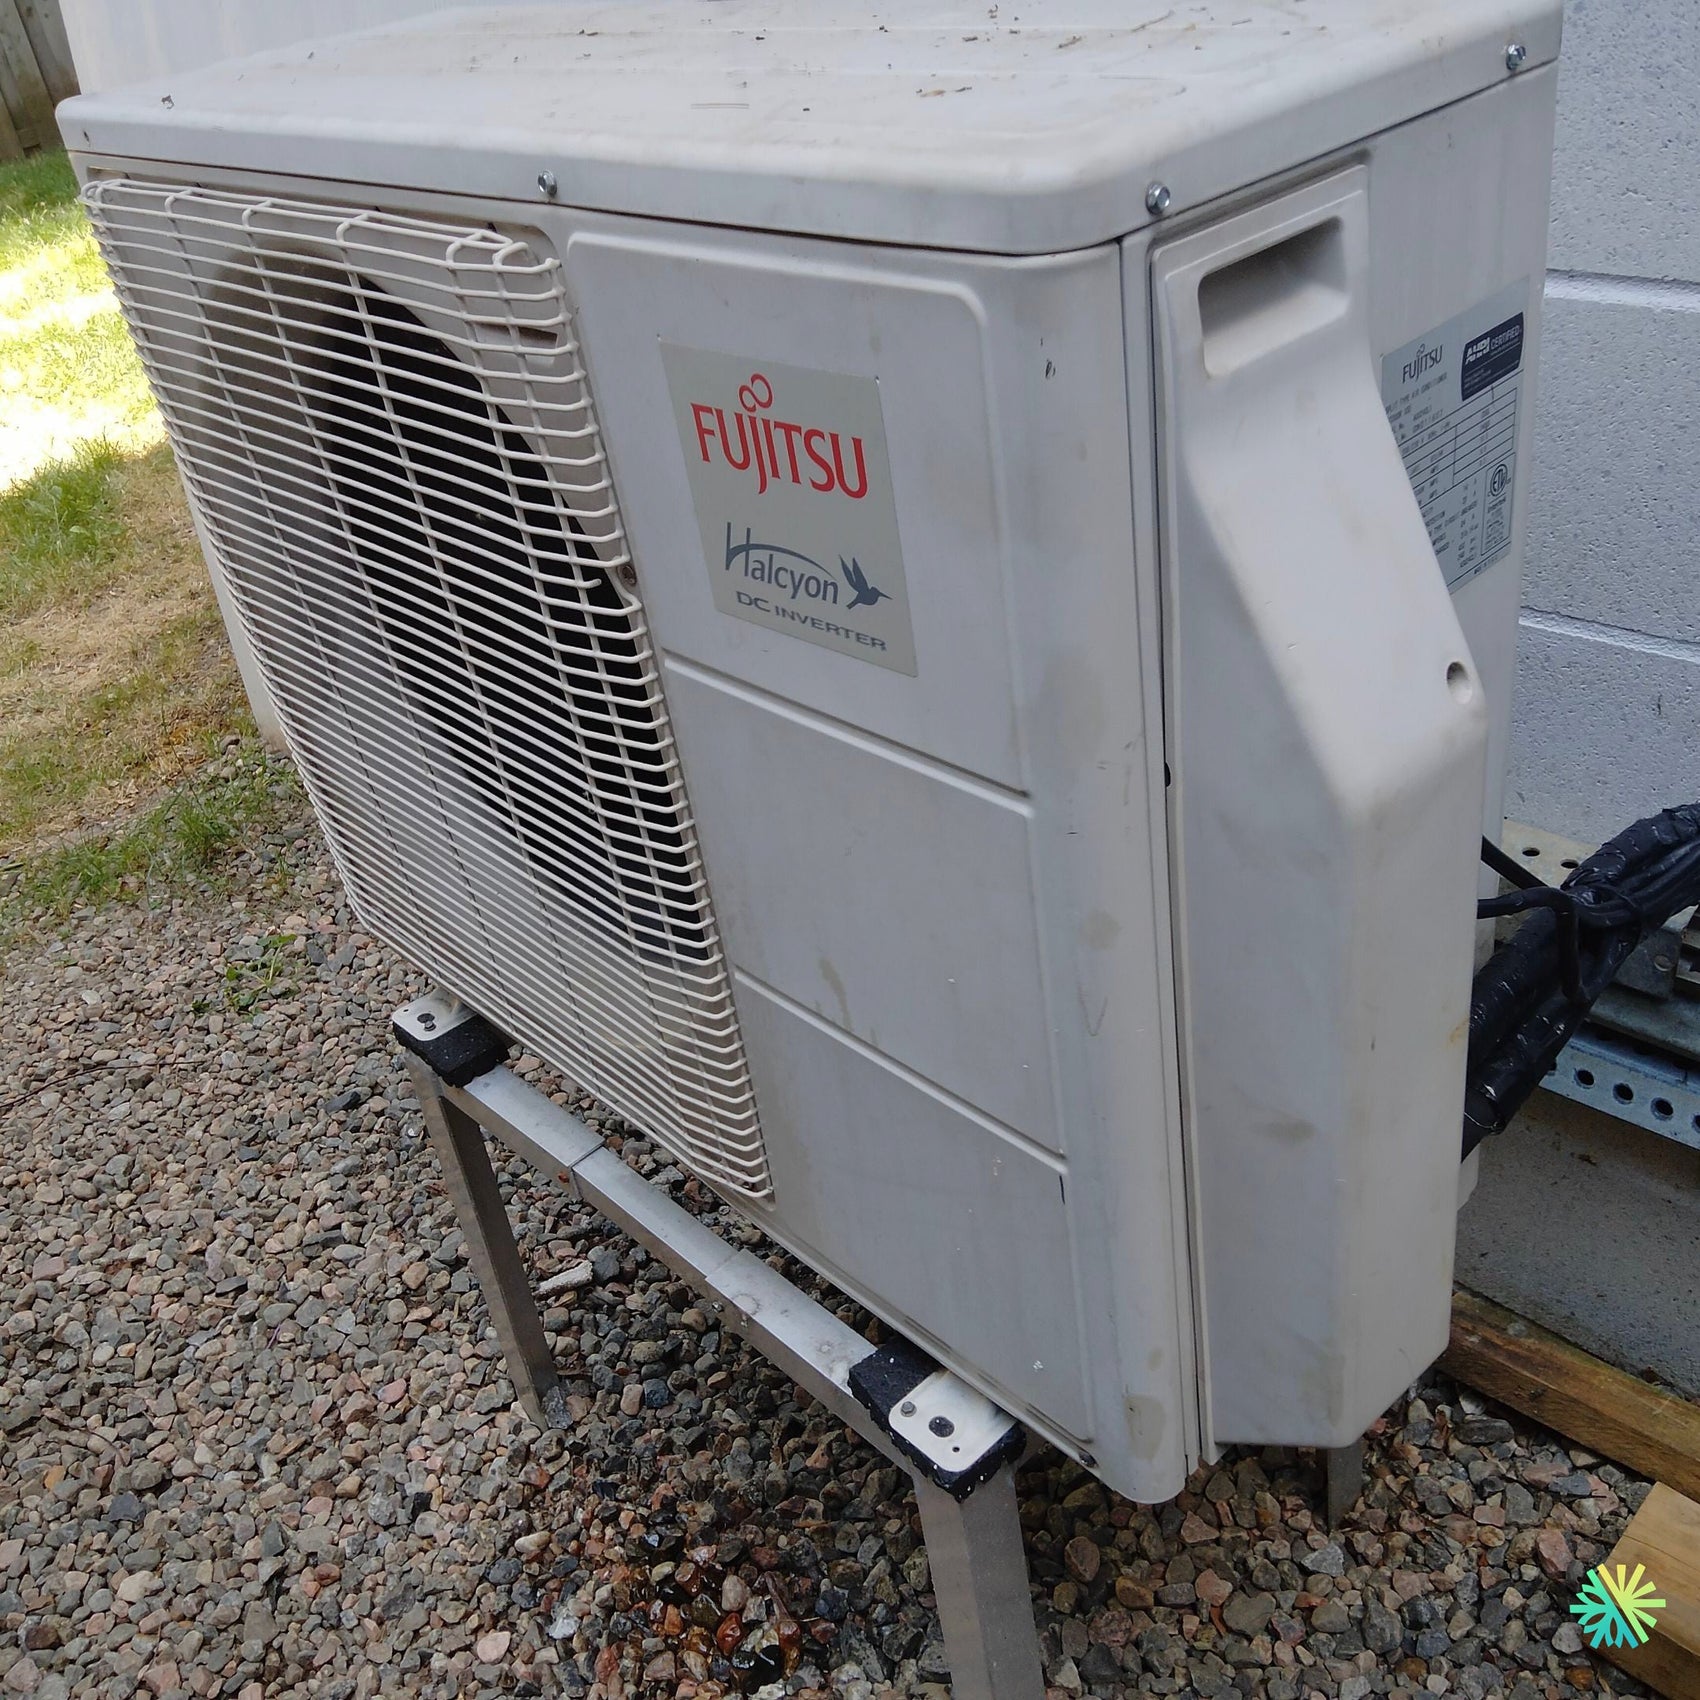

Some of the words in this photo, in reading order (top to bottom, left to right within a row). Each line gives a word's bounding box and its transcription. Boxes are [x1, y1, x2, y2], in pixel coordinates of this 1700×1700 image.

[1402, 344, 1443, 385] FUJITSU
[690, 373, 868, 500] FUJITSU
[725, 522, 839, 605] Halcyon
[736, 591, 771, 613] DC
[775, 605, 888, 652] INVERTER
